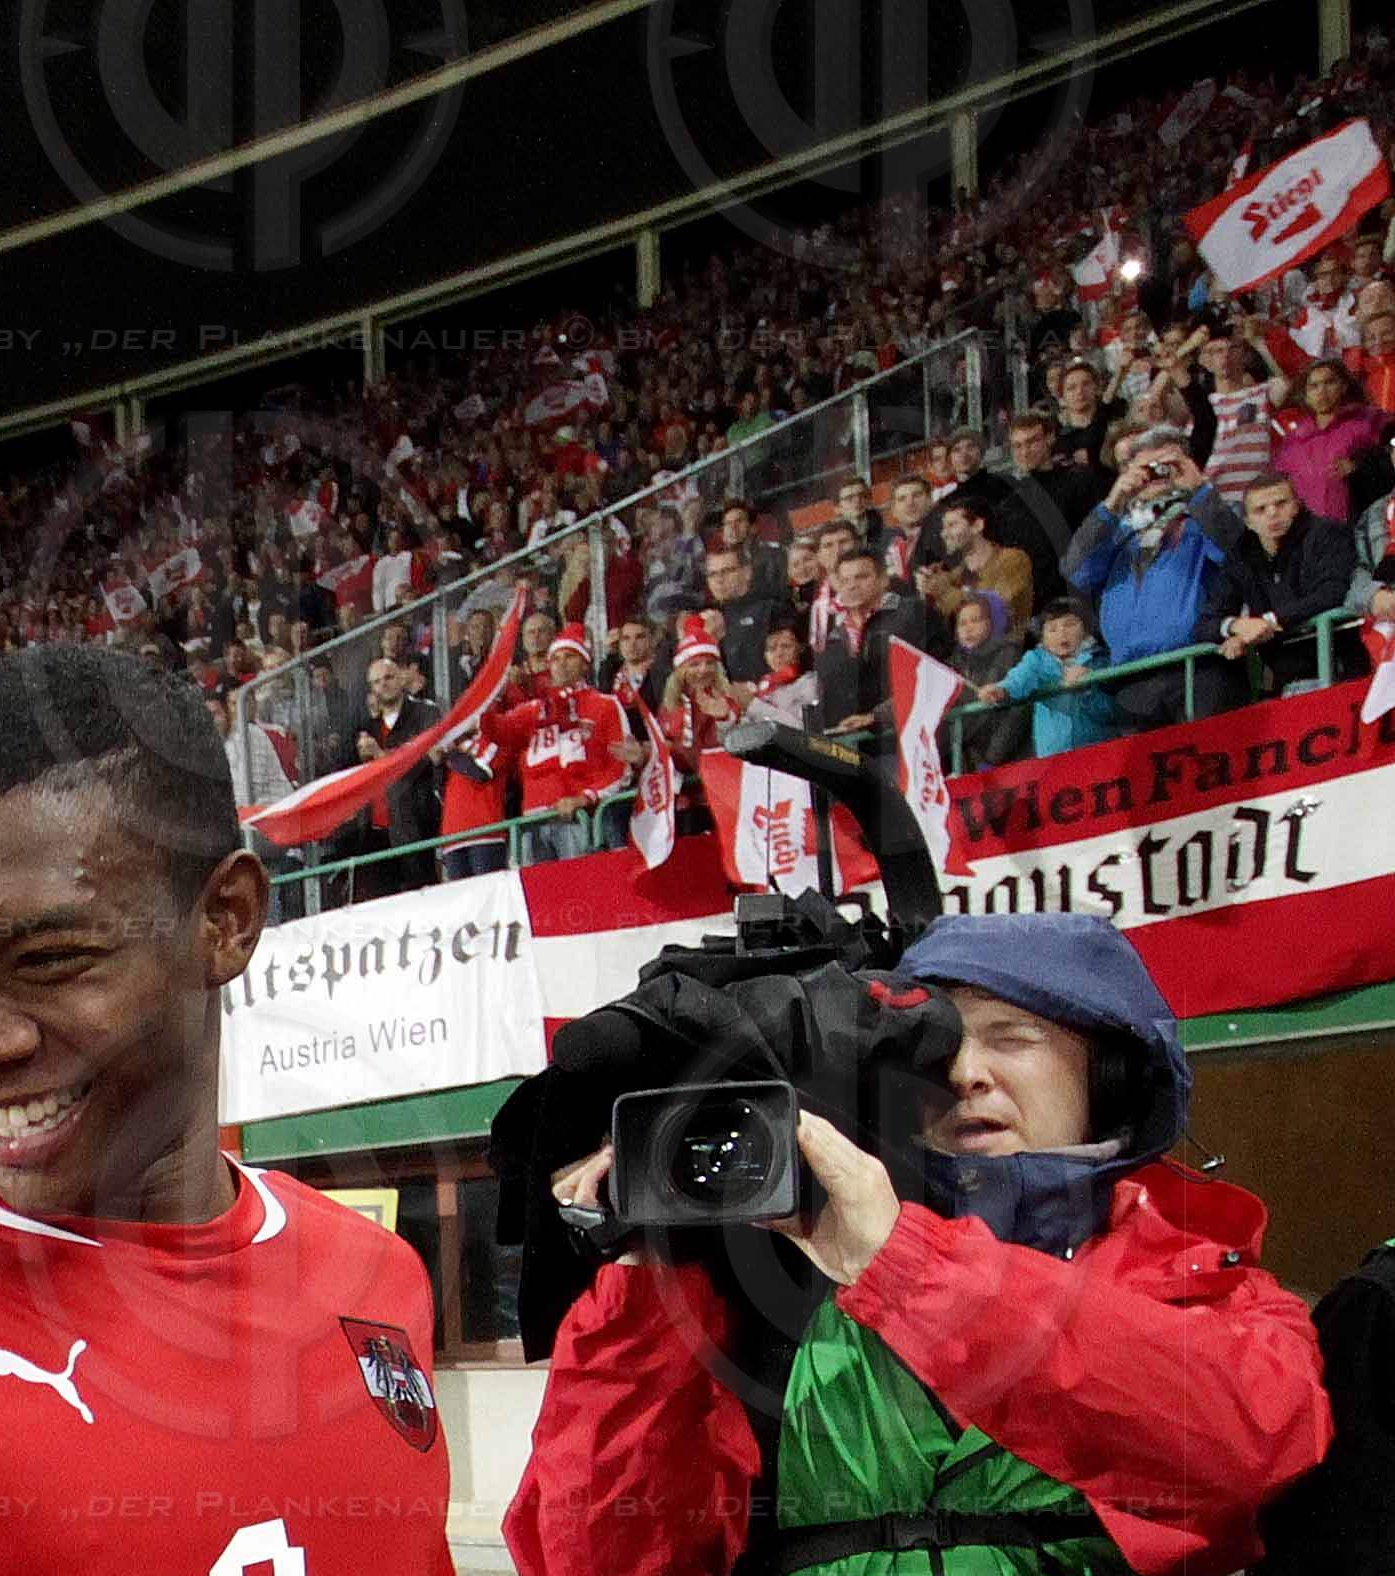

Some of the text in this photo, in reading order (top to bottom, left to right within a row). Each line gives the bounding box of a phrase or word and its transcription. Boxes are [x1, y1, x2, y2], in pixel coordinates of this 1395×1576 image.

[952, 698, 1395, 842] Wien Fancl
[259, 1016, 448, 1076] Austria Wien
